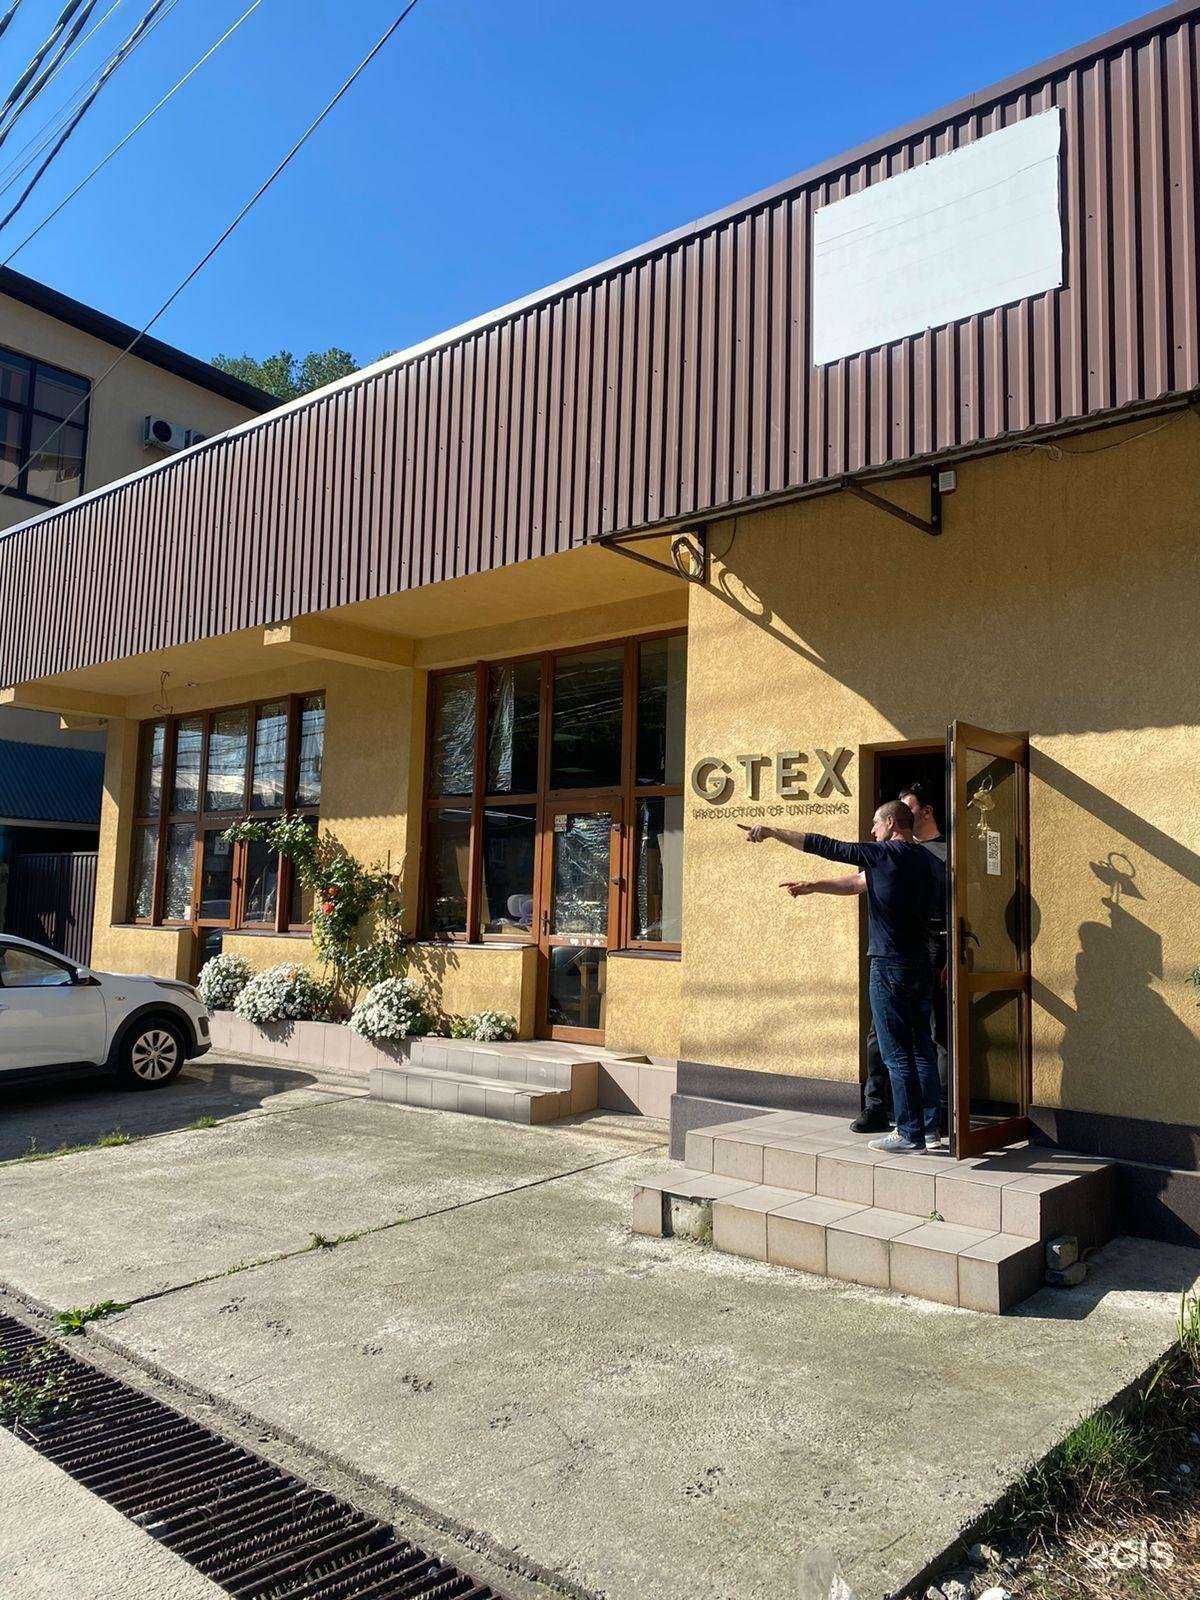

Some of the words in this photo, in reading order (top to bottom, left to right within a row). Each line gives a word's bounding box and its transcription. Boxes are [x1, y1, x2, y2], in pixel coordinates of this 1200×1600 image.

[691, 747, 853, 803] GTEX
[692, 806, 765, 820] PRODUCTION
[768, 804, 784, 817] OF
[785, 802, 850, 816] UNIFORMS
